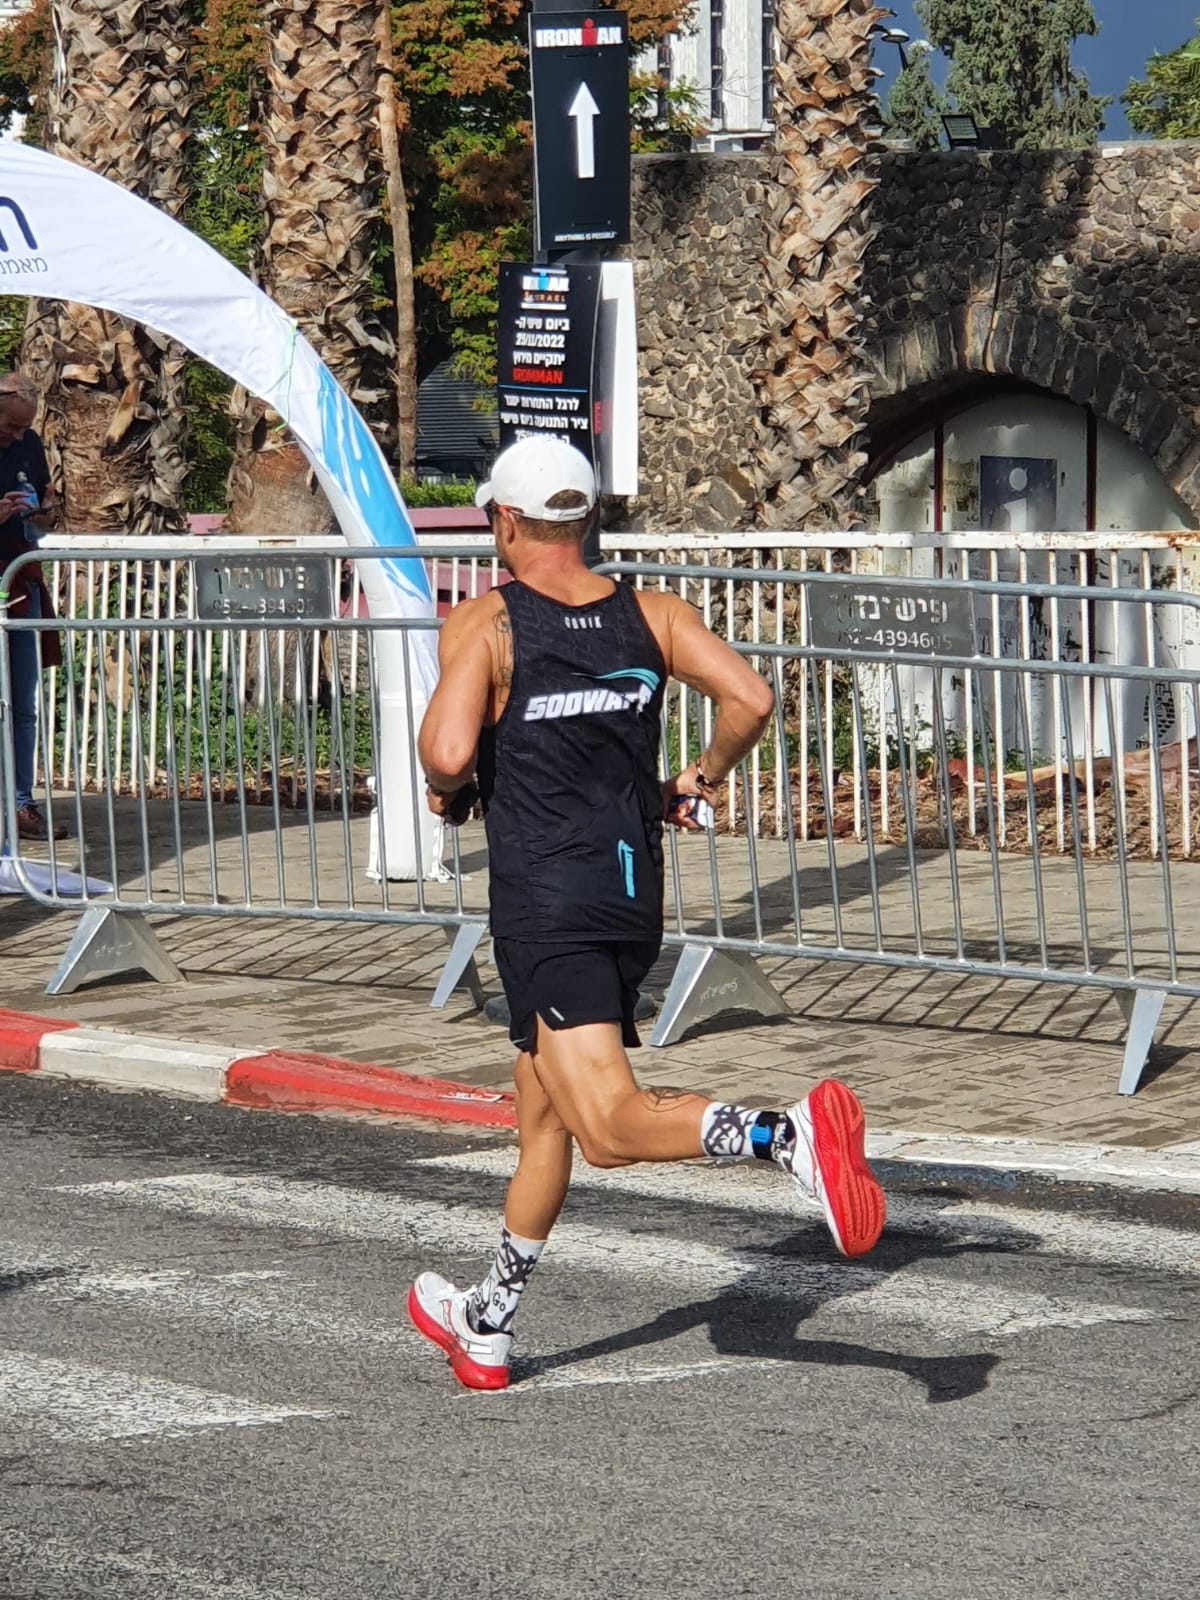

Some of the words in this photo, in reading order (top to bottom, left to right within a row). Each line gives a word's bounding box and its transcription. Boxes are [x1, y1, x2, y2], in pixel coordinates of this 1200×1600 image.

[536, 18, 623, 48] IRONMAN
[545, 317, 570, 331] ביום
[555, 396, 580, 411] לרגל
[570, 416, 589, 430] ציר
